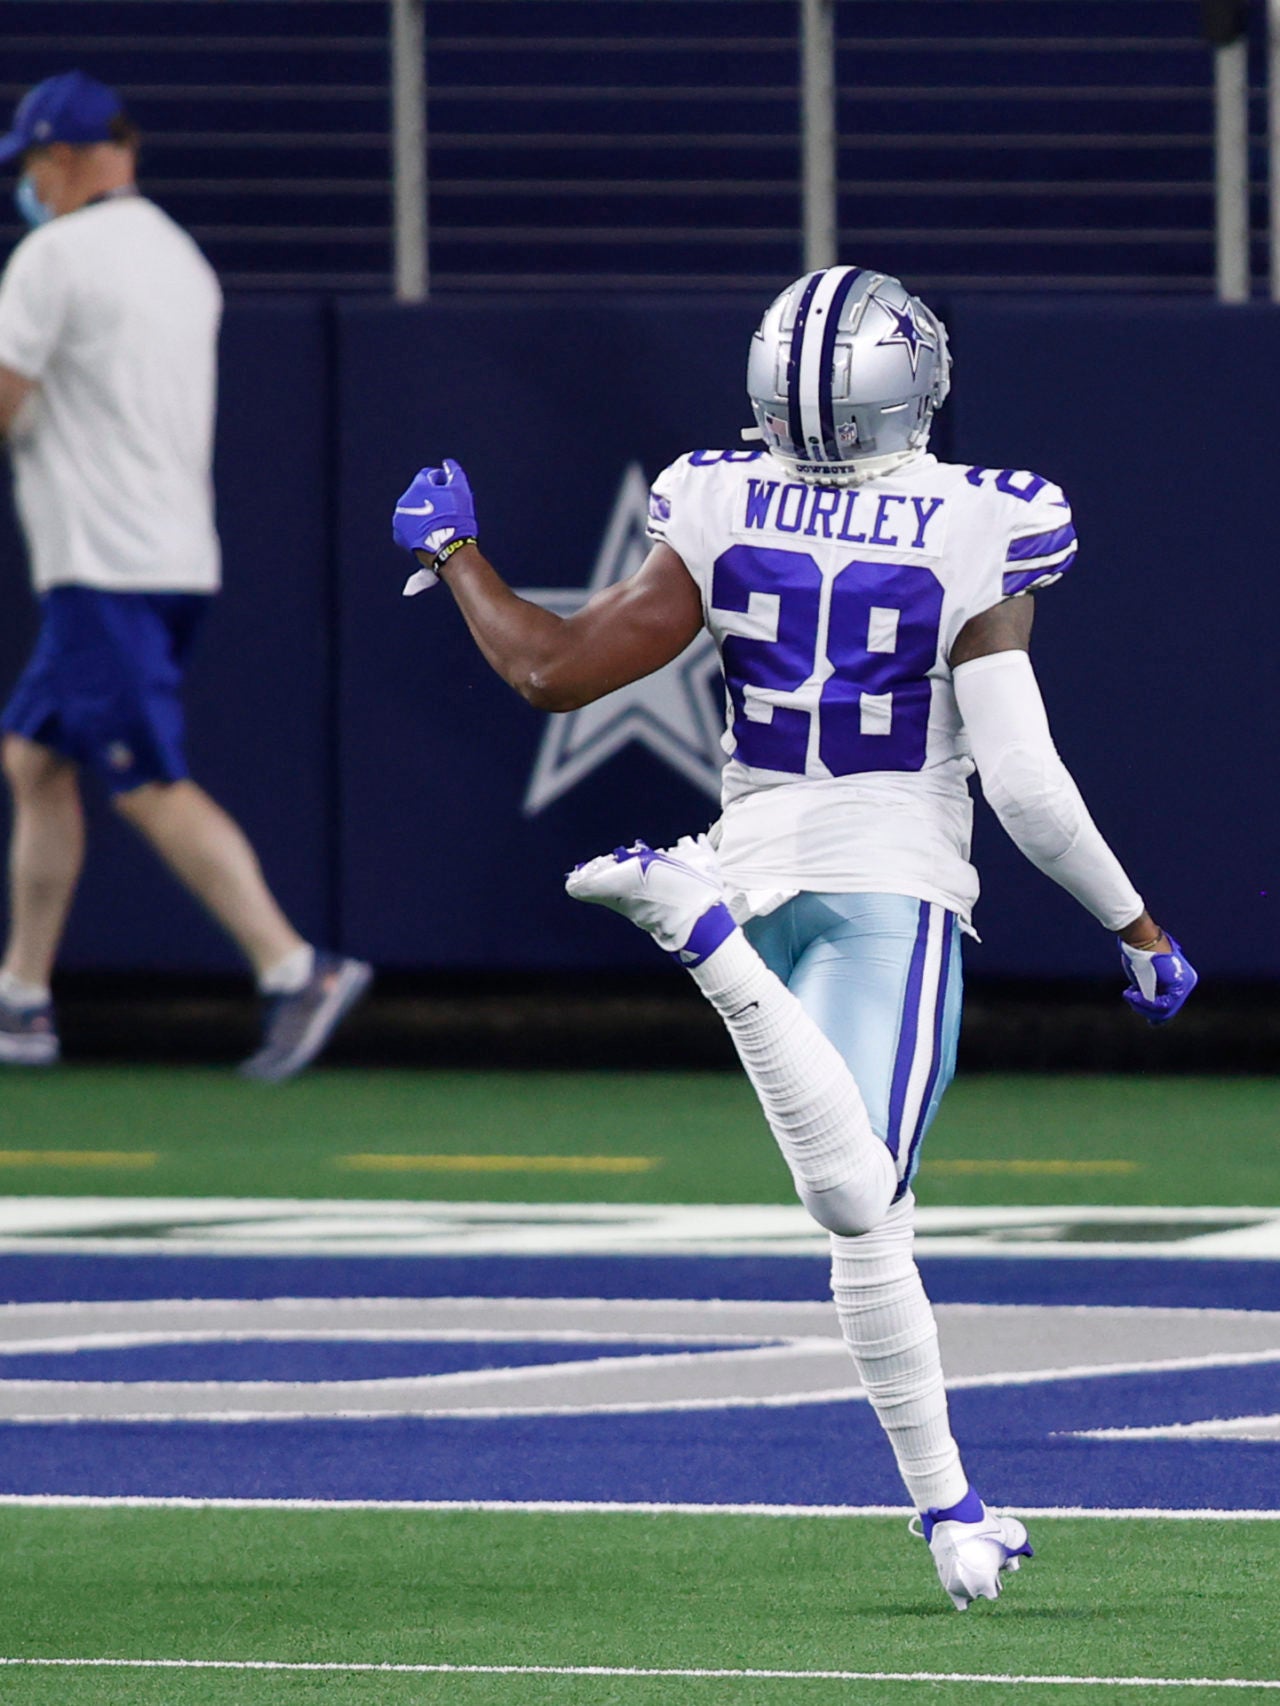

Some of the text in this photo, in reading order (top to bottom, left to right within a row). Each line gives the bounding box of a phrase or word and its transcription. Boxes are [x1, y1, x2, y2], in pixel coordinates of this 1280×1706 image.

[796, 464, 855, 474] COWBOYS
[745, 478, 944, 547] WORLEY
[711, 543, 945, 777] 28
